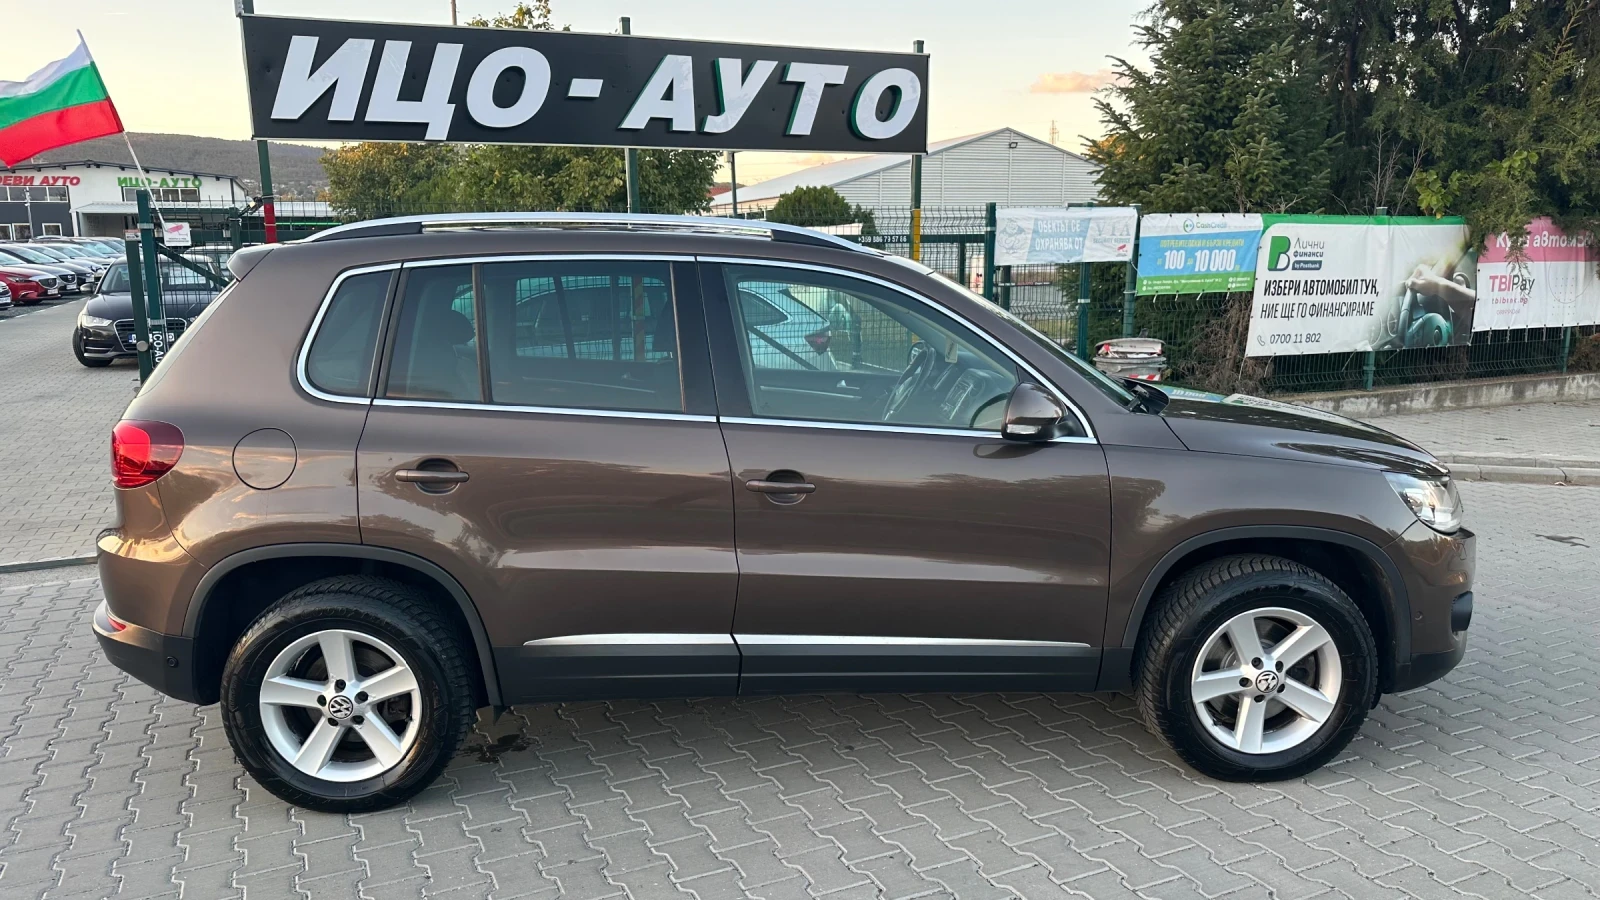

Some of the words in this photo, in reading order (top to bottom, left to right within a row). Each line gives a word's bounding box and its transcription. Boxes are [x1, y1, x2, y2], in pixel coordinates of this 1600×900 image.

[271, 35, 552, 141] ИЦО
[618, 54, 922, 141] АУТО
[40, 175, 81, 186] АУТО
[117, 176, 203, 188] ИЦО-АУТО
[1037, 219, 1069, 233] ОБЕКТЪТ
[1071, 219, 1081, 232] СЕ
[1035, 237, 1073, 250] ОХРАНЯВА
[1074, 237, 1084, 249] ОТ
[1293, 237, 1325, 249] Лични
[1164, 249, 1185, 270] 100
[1293, 249, 1324, 258] Финанси
[1263, 279, 1301, 297] ИЗБЕРИ
[1302, 278, 1360, 295] АВТОМОБИЛ
[1360, 278, 1379, 297] ТУК,
[1260, 303, 1279, 319] НИЕ
[1280, 303, 1296, 321] ЩЕ
[1296, 303, 1307, 318] ГО
[1308, 301, 1374, 318] ФИНАНСИРАМЕ
[1270, 333, 1291, 344] 0700
[1293, 333, 1303, 343] 11
[1304, 332, 1321, 343] 802
